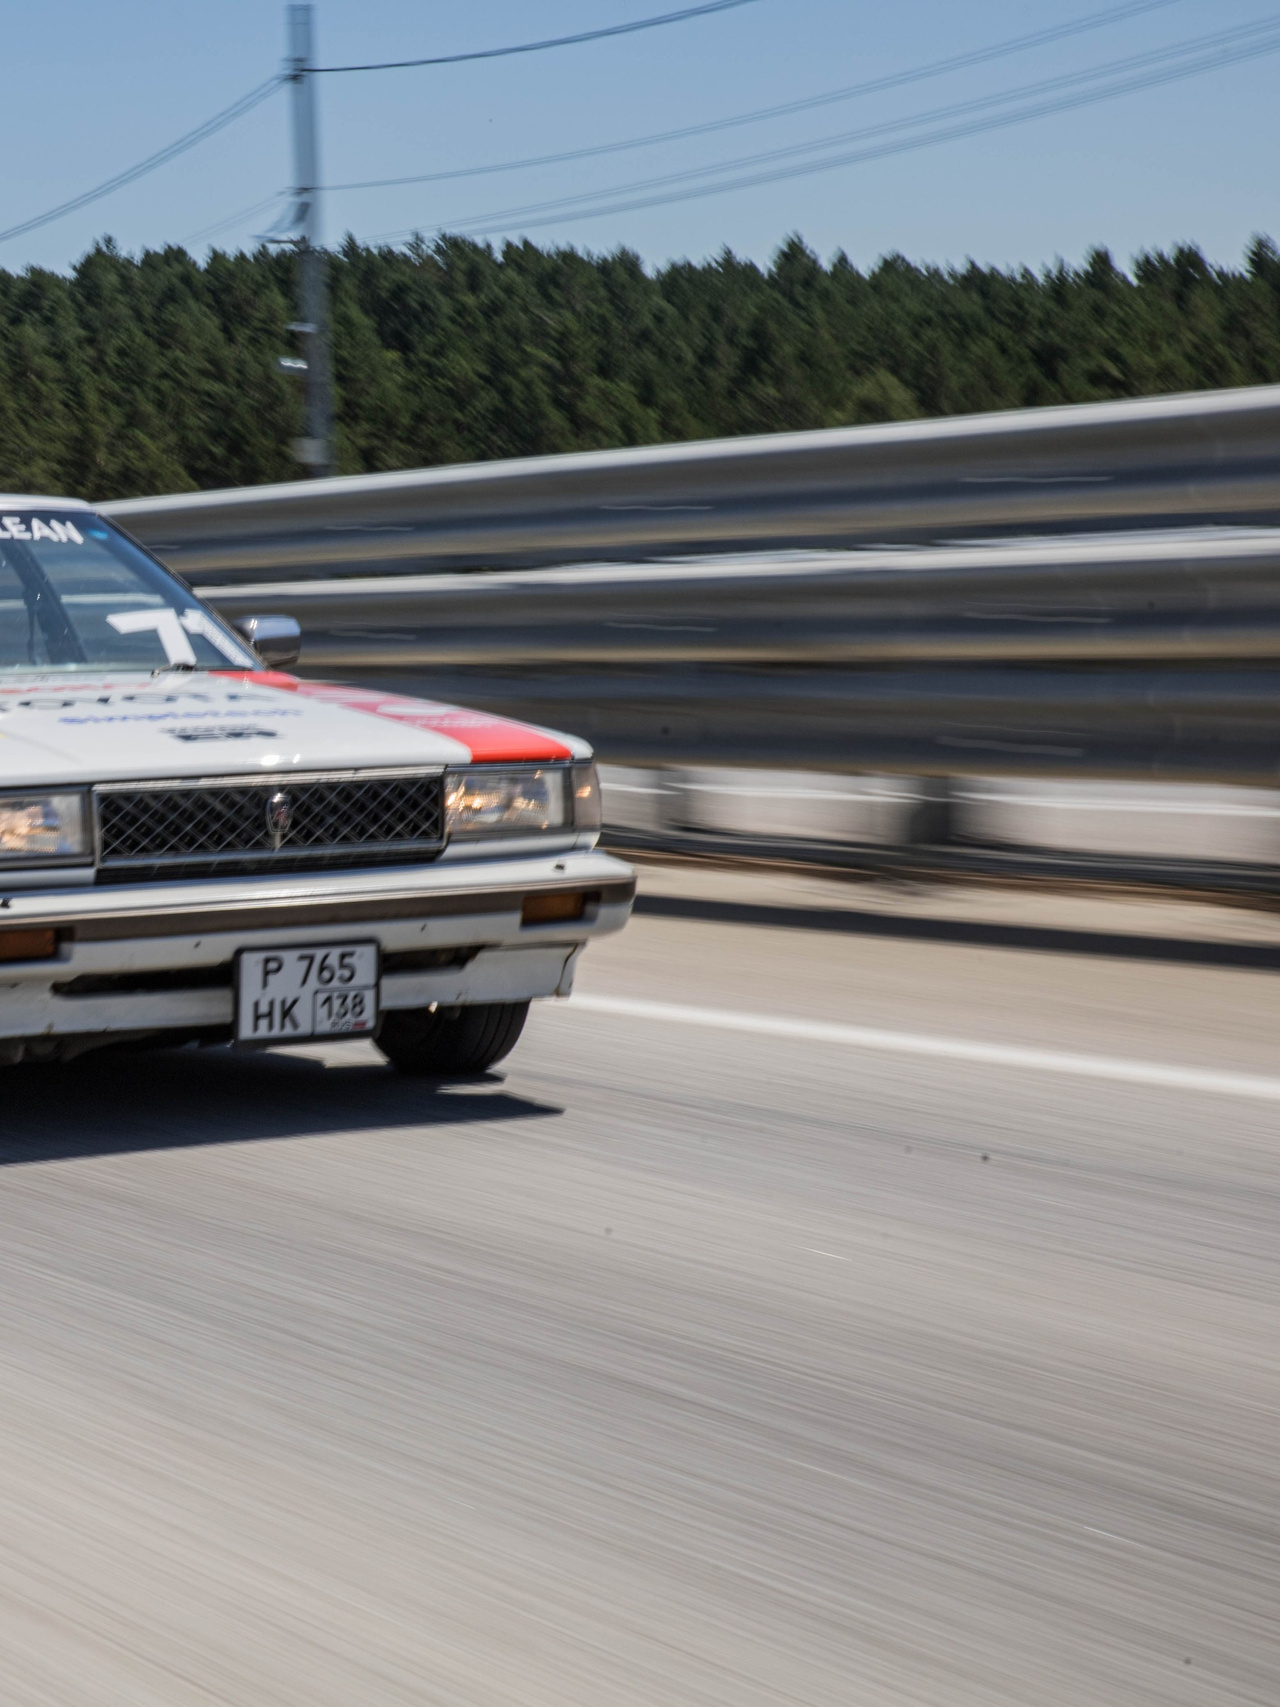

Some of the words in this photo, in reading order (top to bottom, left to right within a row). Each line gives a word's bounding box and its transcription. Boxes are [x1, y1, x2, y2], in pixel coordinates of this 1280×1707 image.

[105, 607, 255, 669] 71
[296, 951, 357, 988] 765
[320, 992, 366, 1020] 138
